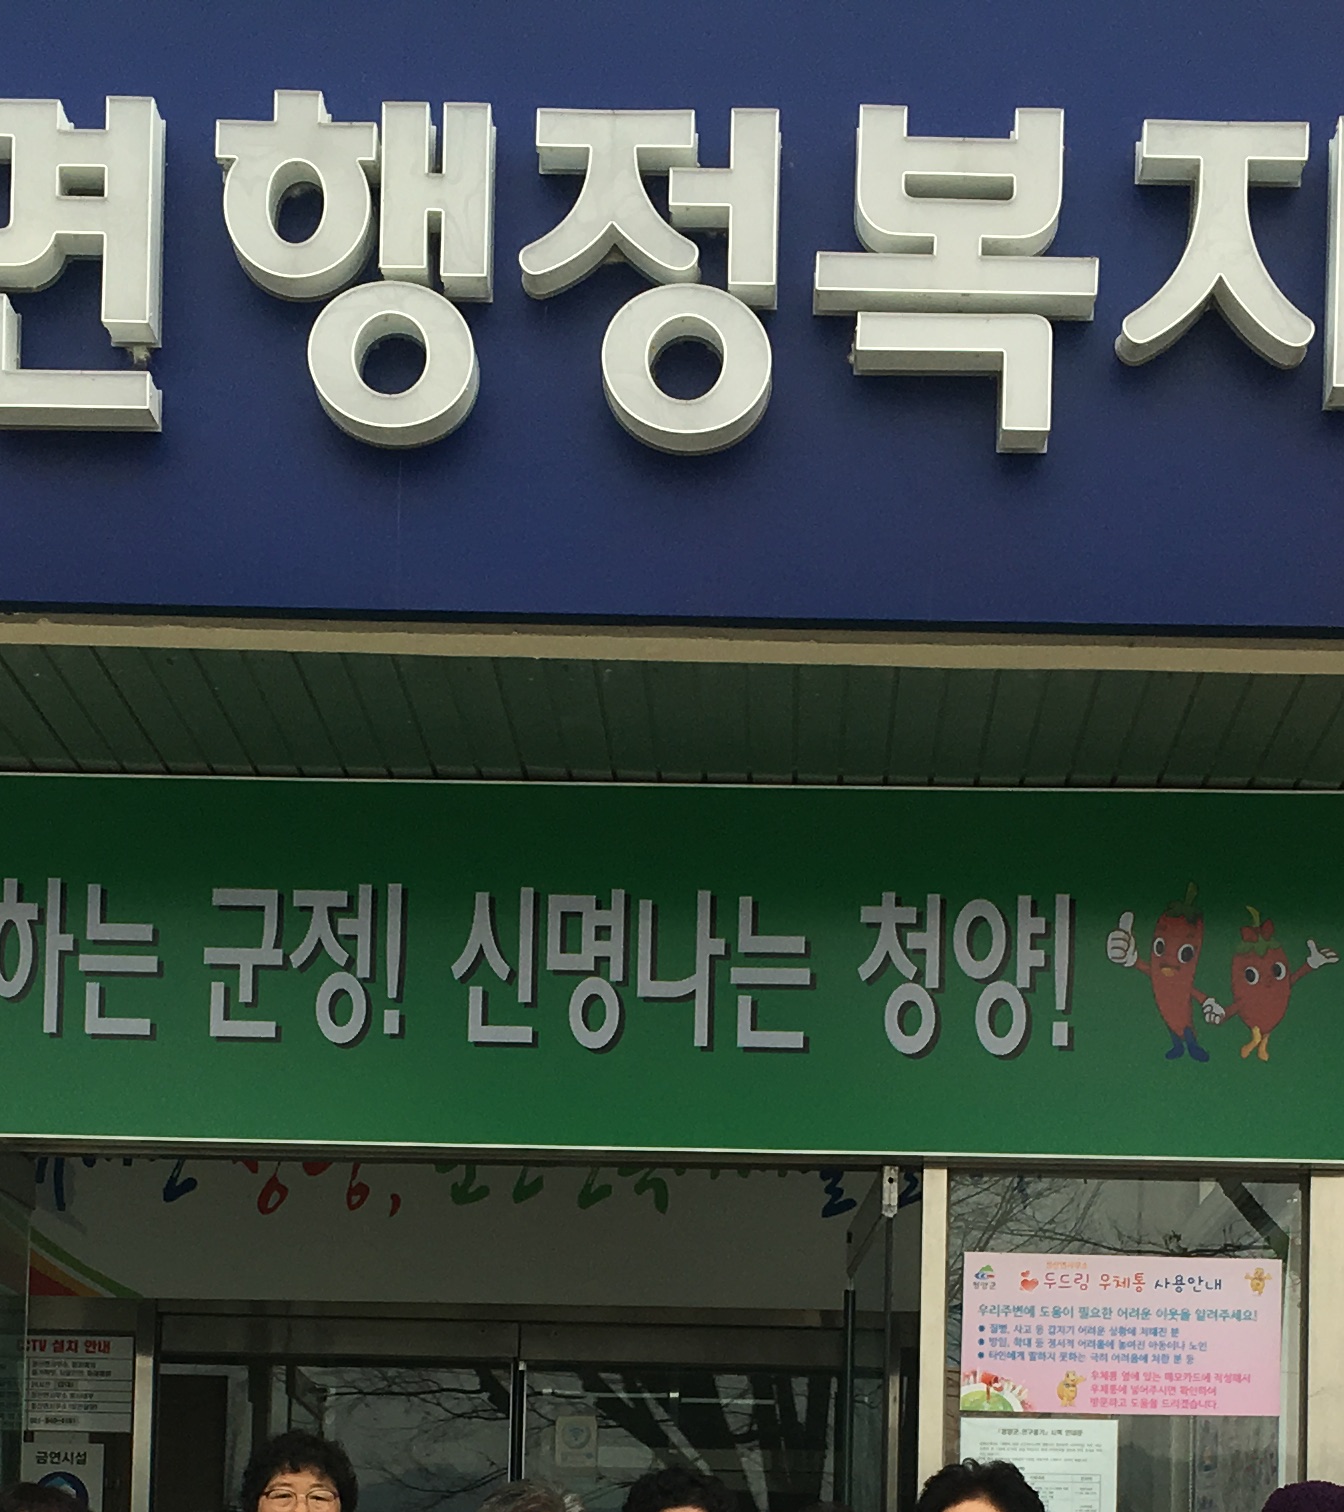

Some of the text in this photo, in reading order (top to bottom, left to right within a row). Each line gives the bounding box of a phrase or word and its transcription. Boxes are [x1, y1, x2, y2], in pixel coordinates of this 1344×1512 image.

[203, 882, 406, 1047] 군정!
[450, 885, 814, 1051] 신명나는
[857, 891, 1073, 1058] 청양!
[1043, 1271, 1222, 1294] 두드림 우체통 사용안내
[978, 1303, 1258, 1322] 우리주변에 도움이 필요한 어려운 이웃을 알려주세요!
[83, 1340, 112, 1354] 안내
[36, 1451, 87, 1466] 금연시설
